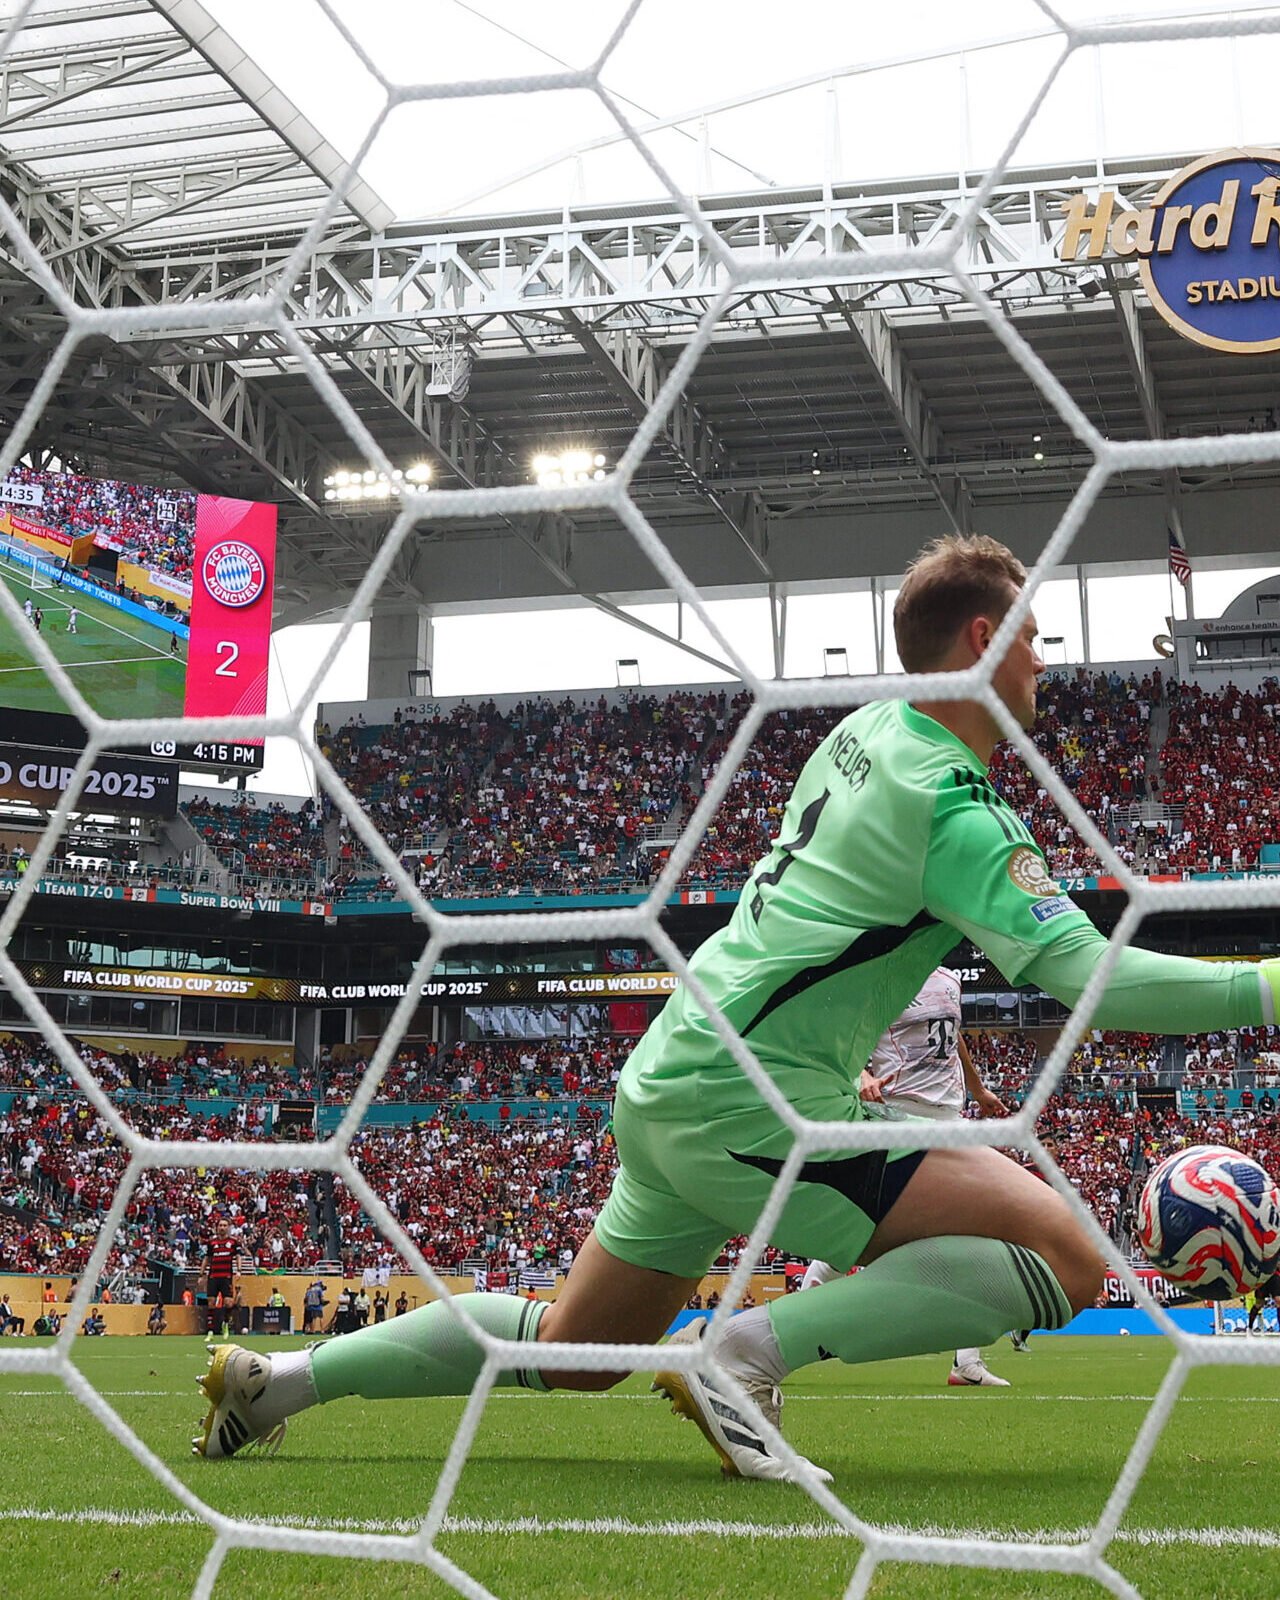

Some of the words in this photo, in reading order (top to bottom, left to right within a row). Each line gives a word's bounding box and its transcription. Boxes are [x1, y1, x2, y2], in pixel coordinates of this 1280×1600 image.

[1060, 179, 1241, 262] Hard
[207, 552, 221, 567] FC
[221, 545, 260, 573] BAYERN
[50, 566, 71, 581] WOLD
[94, 587, 122, 606] TICKETS
[1251, 622, 1278, 631] health
[215, 641, 239, 677] 2
[419, 703, 441, 714] 356
[152, 741, 175, 755] CC
[193, 743, 228, 761] 4:15
[233, 747, 255, 764] PM
[827, 727, 872, 793] NEUER
[19, 763, 74, 790] CUP
[0, 880, 40, 894] EASN
[44, 881, 77, 896] TEAM
[83, 885, 114, 900] 17-0
[1065, 878, 1086, 891] 75
[180, 892, 217, 908] SUPER
[220, 894, 254, 911] BOWL
[258, 899, 281, 913] VIII
[64, 970, 93, 984] FIFA
[96, 972, 131, 986] CLUB
[133, 974, 183, 989] WORLD
[185, 977, 213, 991] CUP
[537, 980, 567, 993] FIFA
[568, 979, 604, 993] CLUB
[606, 977, 658, 992] WORLD
[660, 976, 680, 989] CU
[300, 985, 328, 999] FIFA
[332, 985, 366, 999] CLUB
[420, 984, 446, 996] CUP
